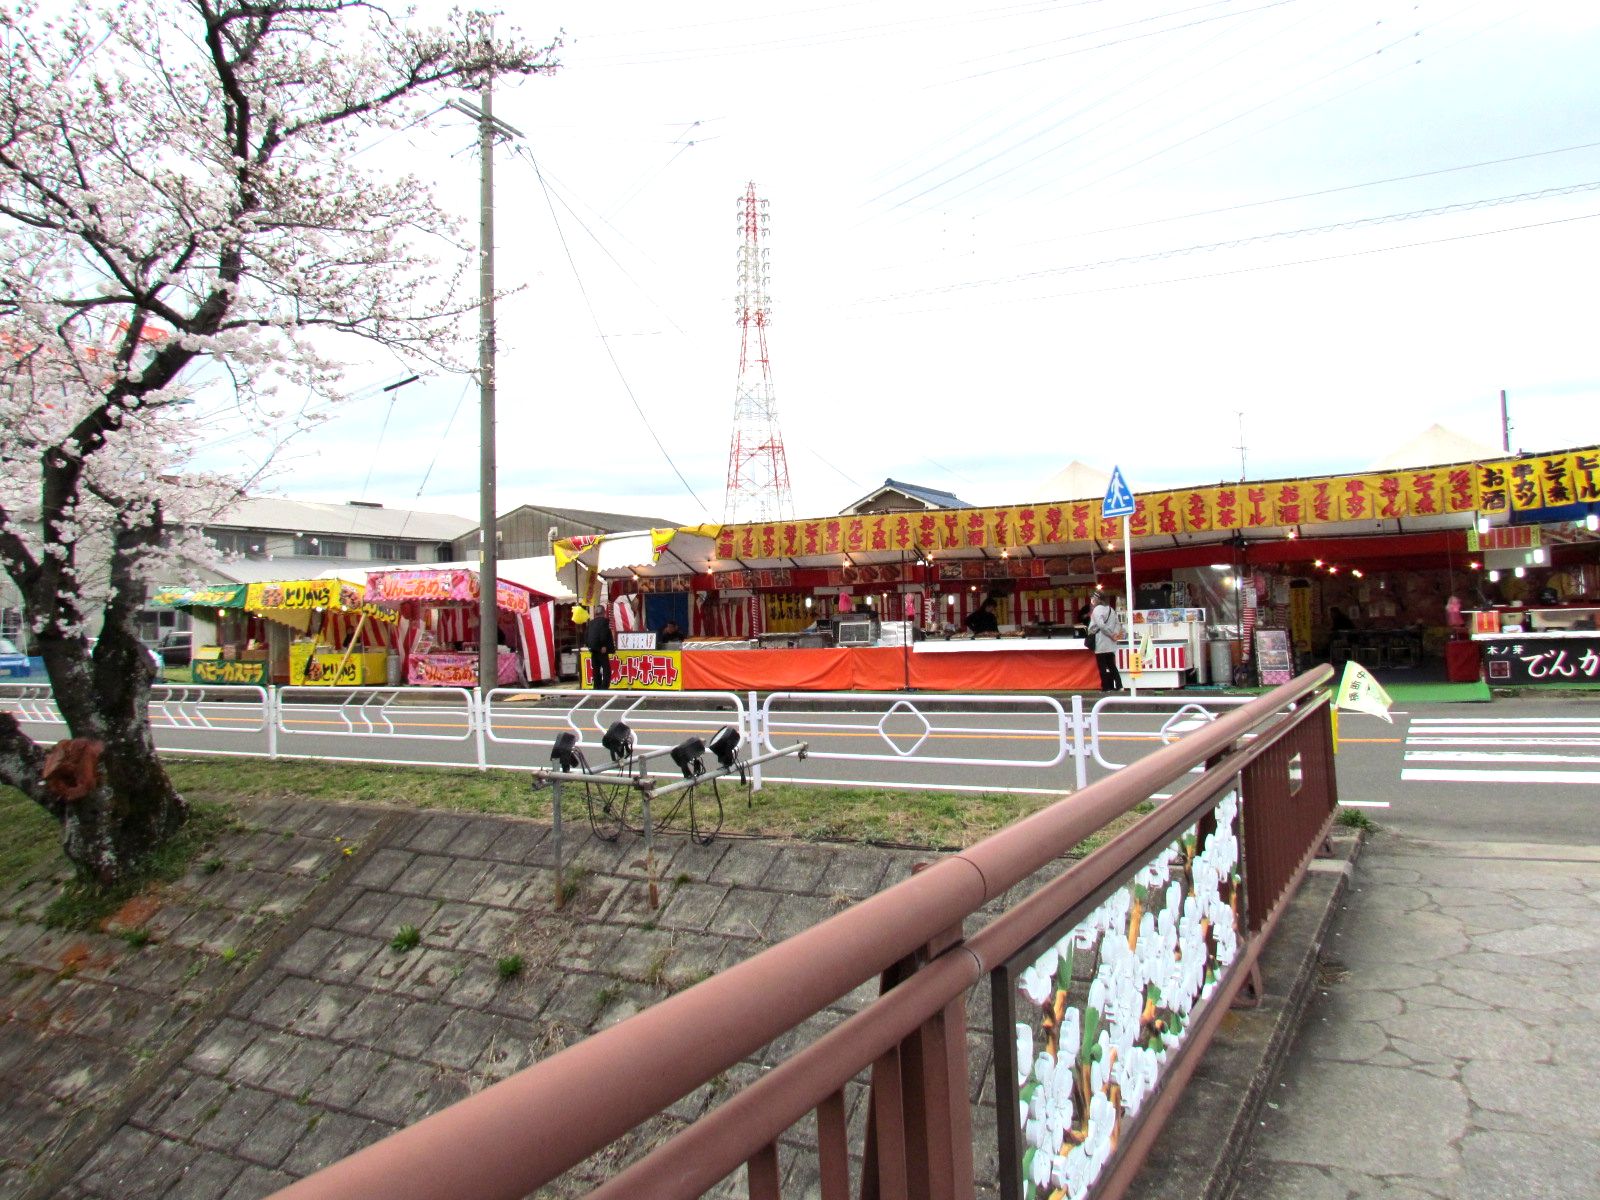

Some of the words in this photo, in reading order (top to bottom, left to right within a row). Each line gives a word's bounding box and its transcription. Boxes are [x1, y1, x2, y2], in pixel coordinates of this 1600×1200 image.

[1413, 473, 1435, 514] どて煮
[1481, 468, 1505, 510] お酒
[1511, 464, 1536, 506] 串カツ
[1543, 458, 1569, 503] どて煮
[1576, 454, 1600, 499] ビール
[1217, 491, 1237, 527] お茶
[1248, 488, 1266, 526] ビール
[1279, 485, 1299, 523] お酒
[1345, 480, 1365, 518] 串カツ
[945, 514, 959, 548] ビール
[967, 512, 985, 546] お酒
[195, 663, 263, 683] ベビーカステラ
[585, 655, 678, 685] トネードポテト
